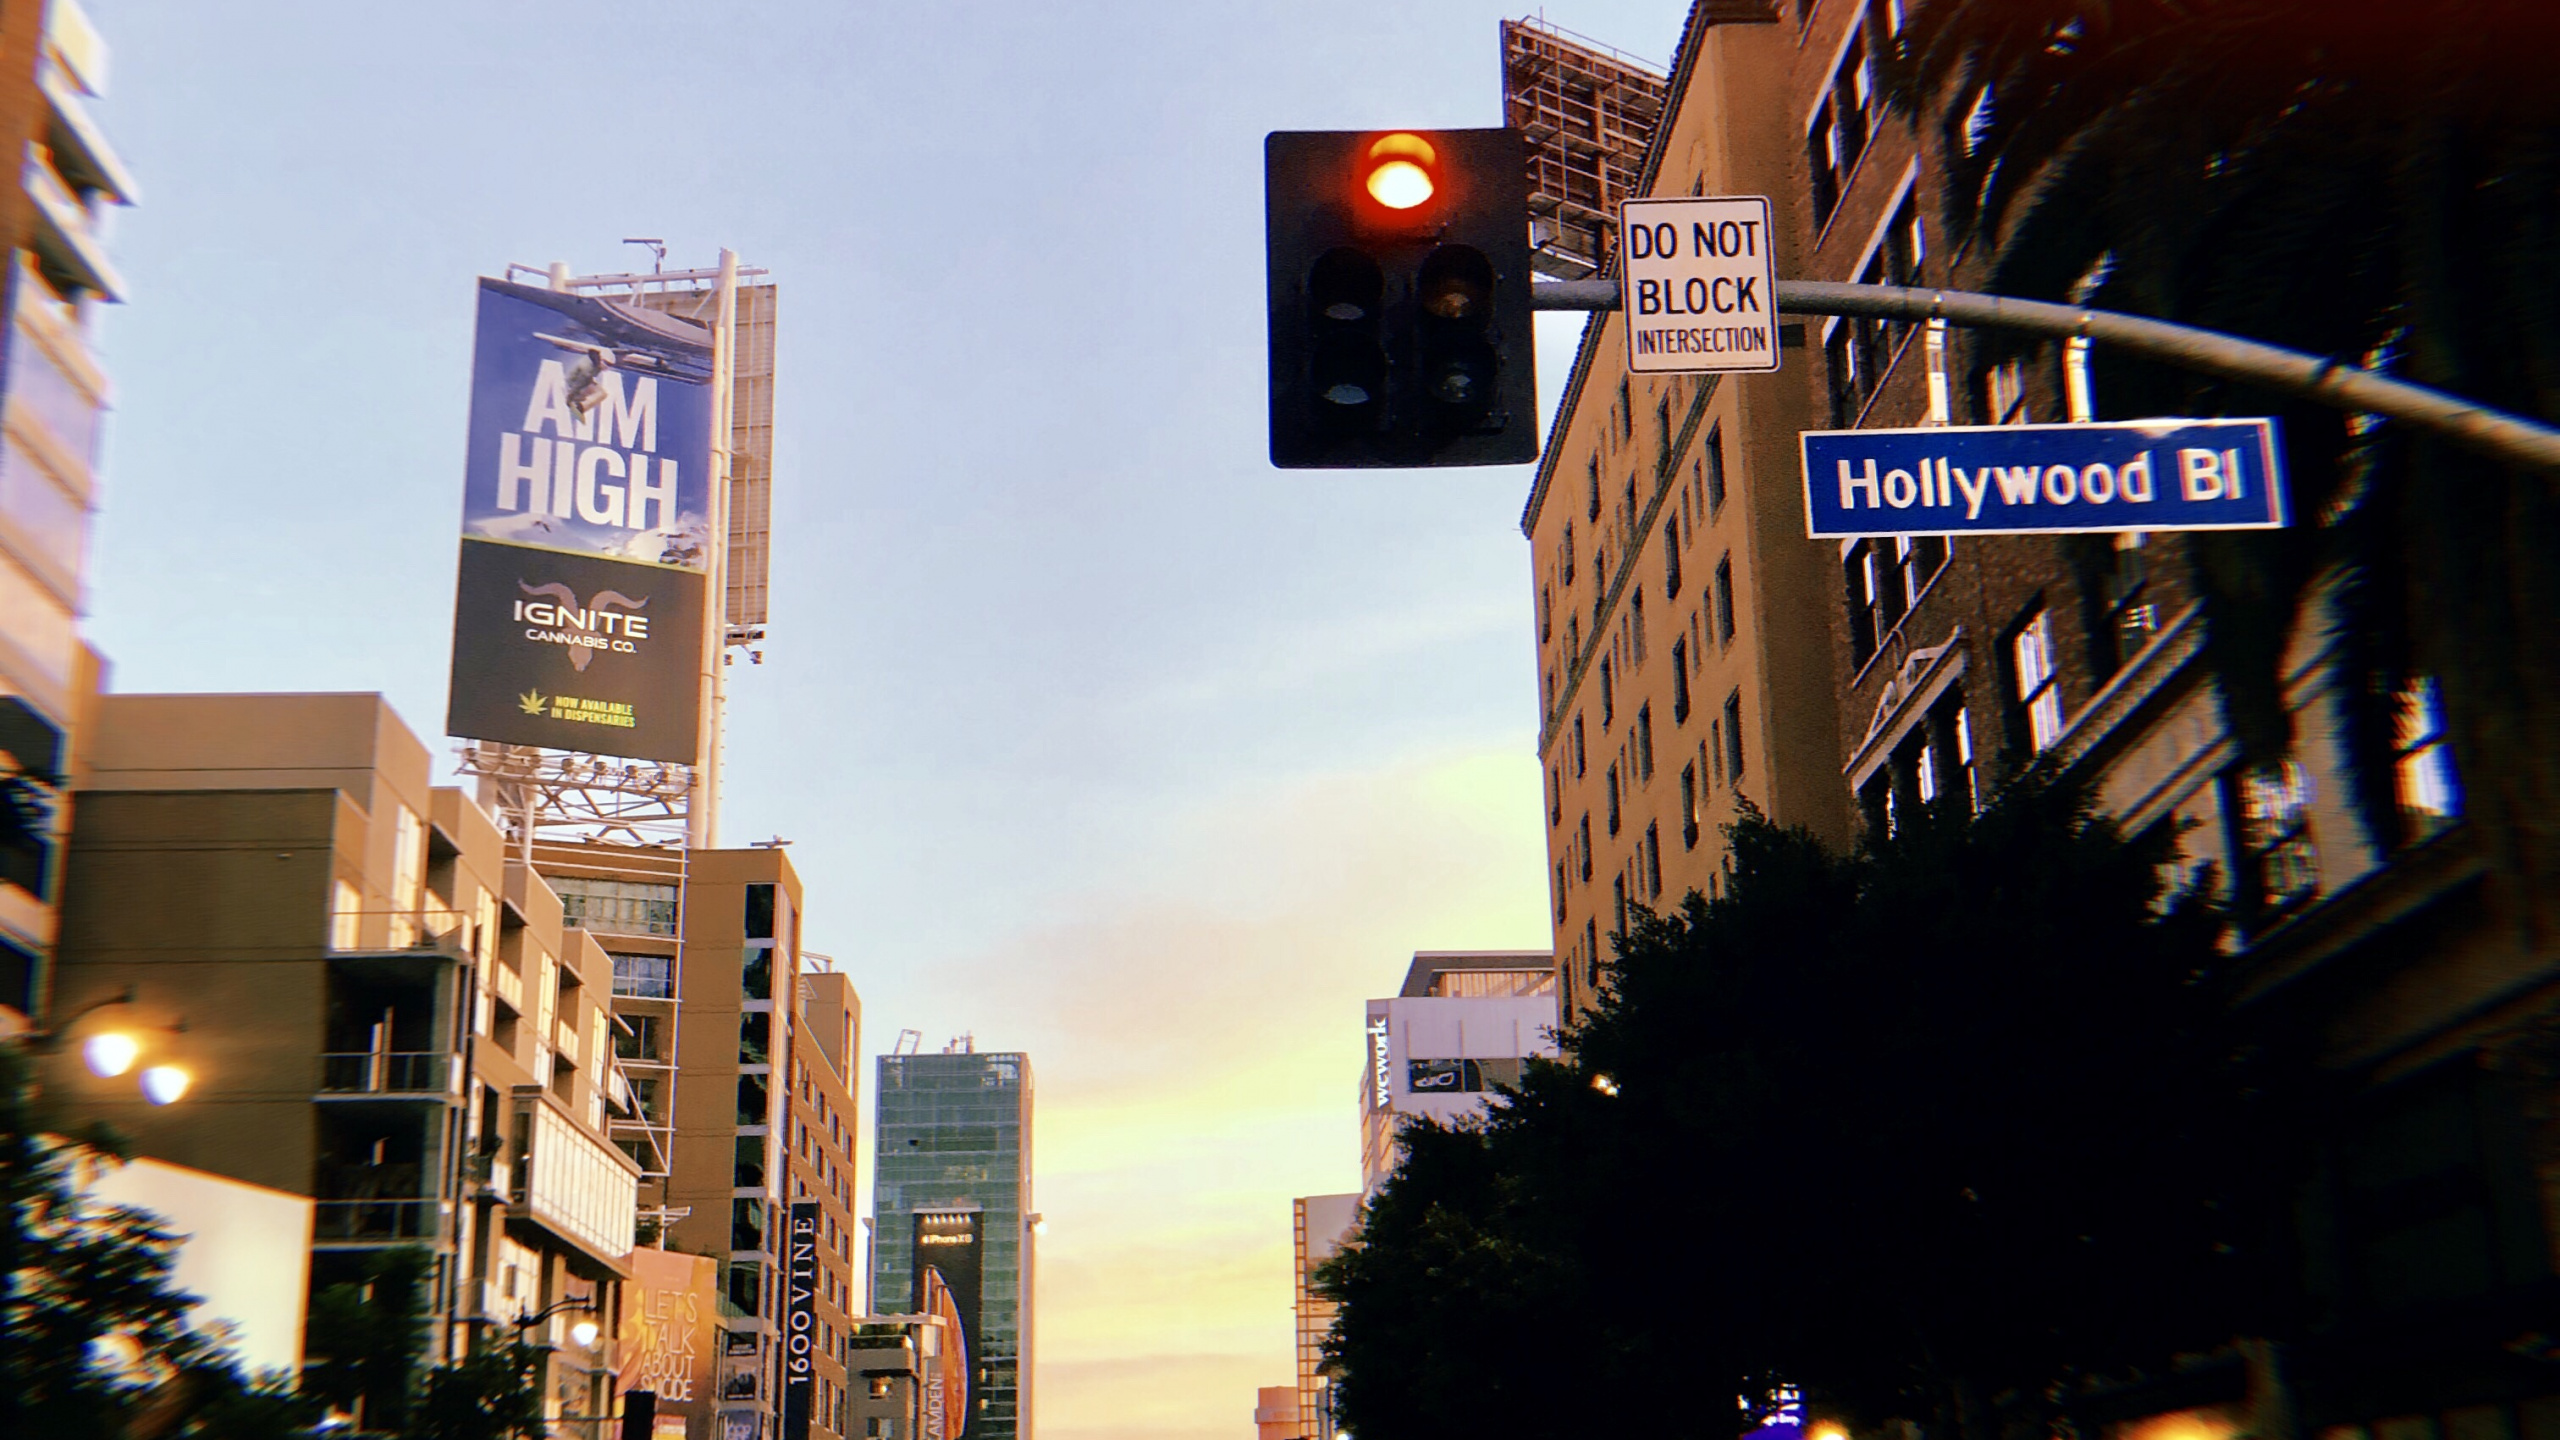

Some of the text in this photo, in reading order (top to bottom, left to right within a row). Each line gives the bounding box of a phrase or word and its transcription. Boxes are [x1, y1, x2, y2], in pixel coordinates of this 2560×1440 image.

[1630, 220, 1760, 259] DO NOT
[1637, 276, 1761, 315] BLOCK
[1637, 326, 1767, 355] INTERSECTION
[496, 431, 678, 534] HIGH
[1836, 447, 2248, 520] Hollywood Bl
[513, 599, 649, 639] IGNITE
[525, 628, 638, 653] CANNABIS CO.
[551, 706, 636, 728] IN DISPENSARIES
[555, 695, 634, 716] NOW AVAILABLE
[1366, 1017, 1390, 1109] wework
[645, 1288, 698, 1323] LET'S
[788, 1217, 815, 1386] 1600 VINE
[645, 1319, 695, 1355] TALK
[640, 1350, 695, 1380] ABOUT
[926, 1378, 945, 1440] AMDEN
